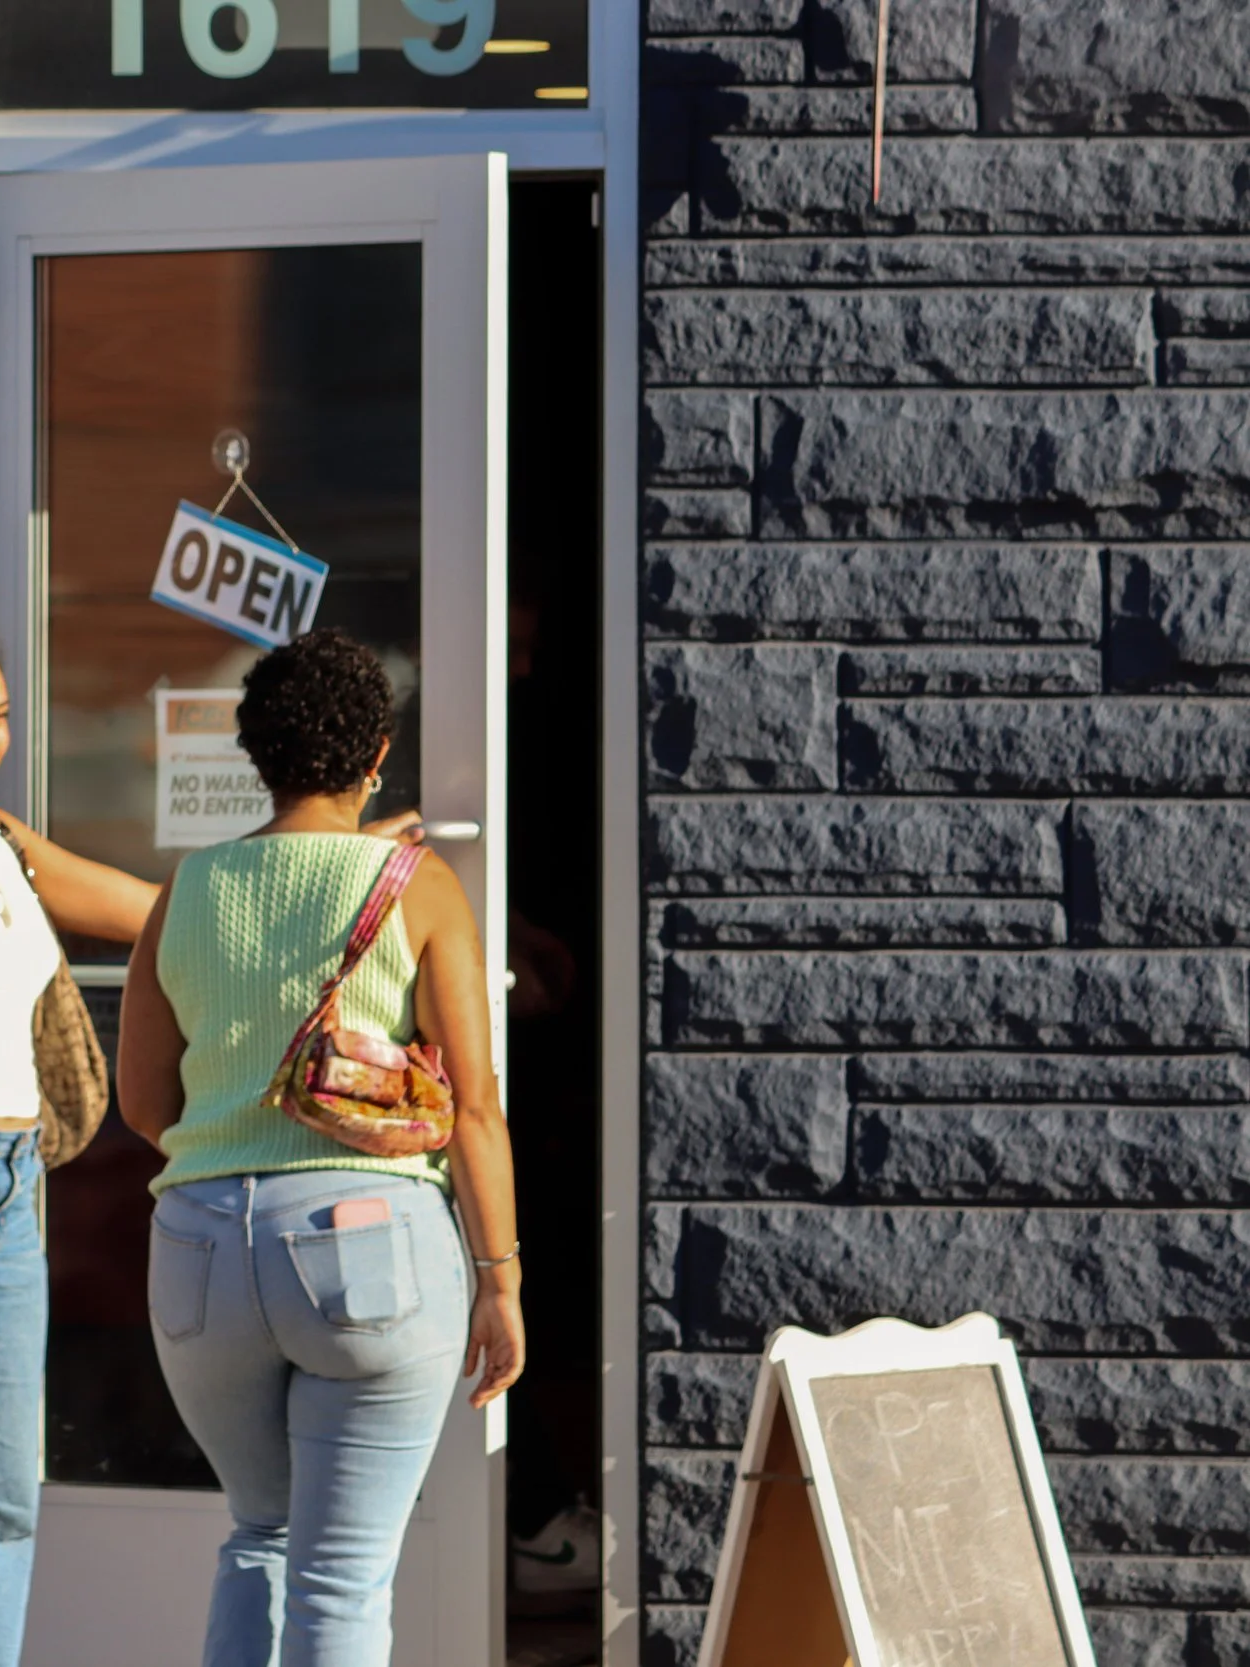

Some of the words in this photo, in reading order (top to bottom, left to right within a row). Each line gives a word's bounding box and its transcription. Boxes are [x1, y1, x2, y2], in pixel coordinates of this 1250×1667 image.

[111, 0, 497, 79] 1619
[169, 527, 314, 640] OPEN
[169, 796, 199, 816] NO
[203, 796, 268, 817] ENTRY
[170, 773, 199, 793] NO
